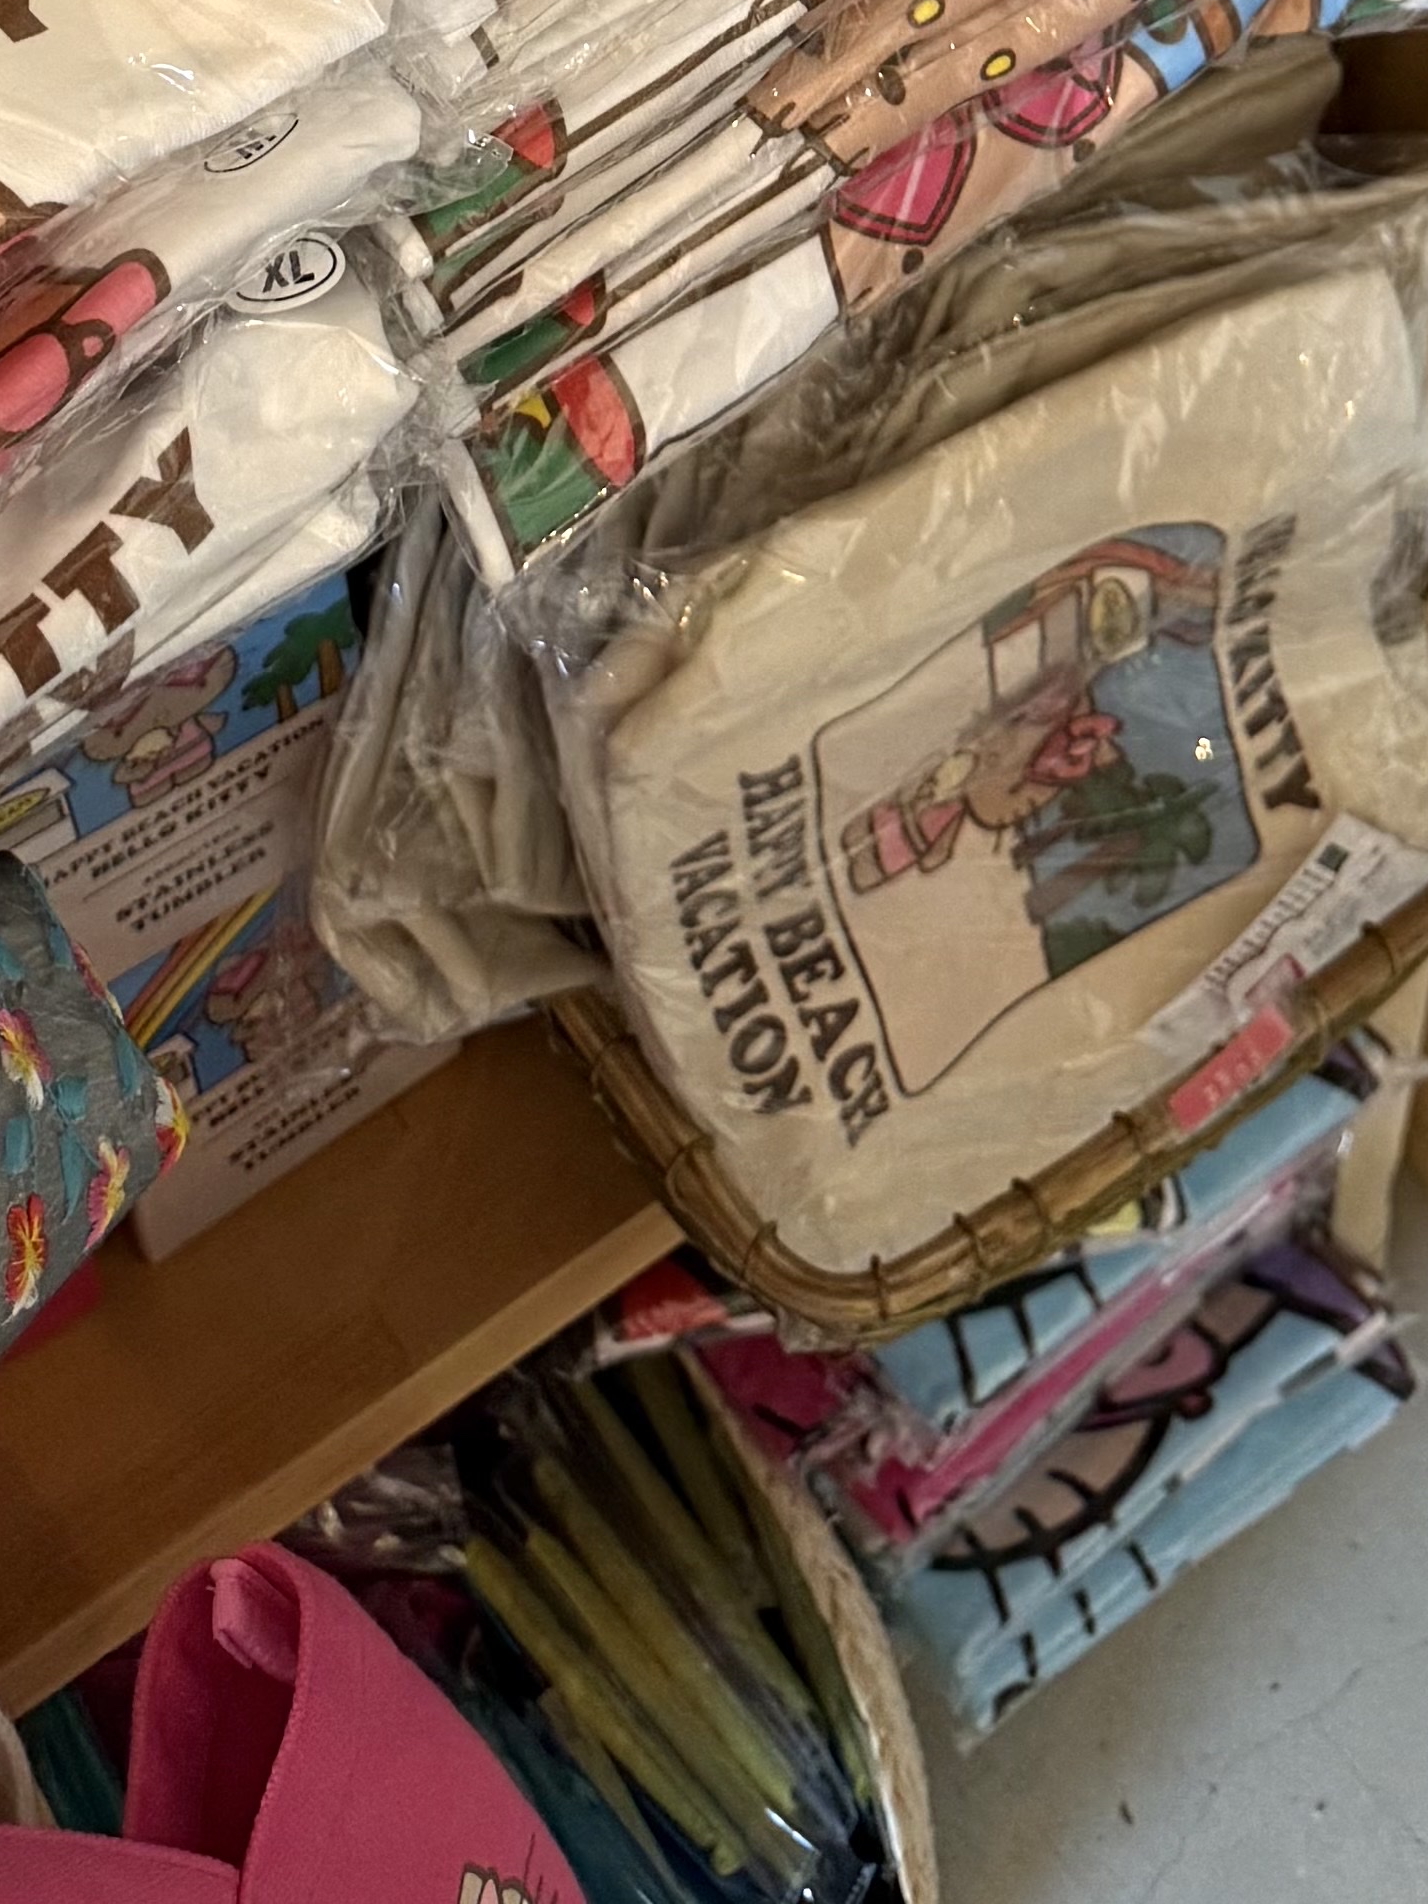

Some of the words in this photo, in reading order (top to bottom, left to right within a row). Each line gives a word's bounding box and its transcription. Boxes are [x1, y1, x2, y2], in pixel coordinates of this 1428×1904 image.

[262, 250, 315, 293] XL
[42, 843, 113, 889] APPY
[670, 831, 817, 1117] VACATION
[767, 912, 891, 1149] BEACH
